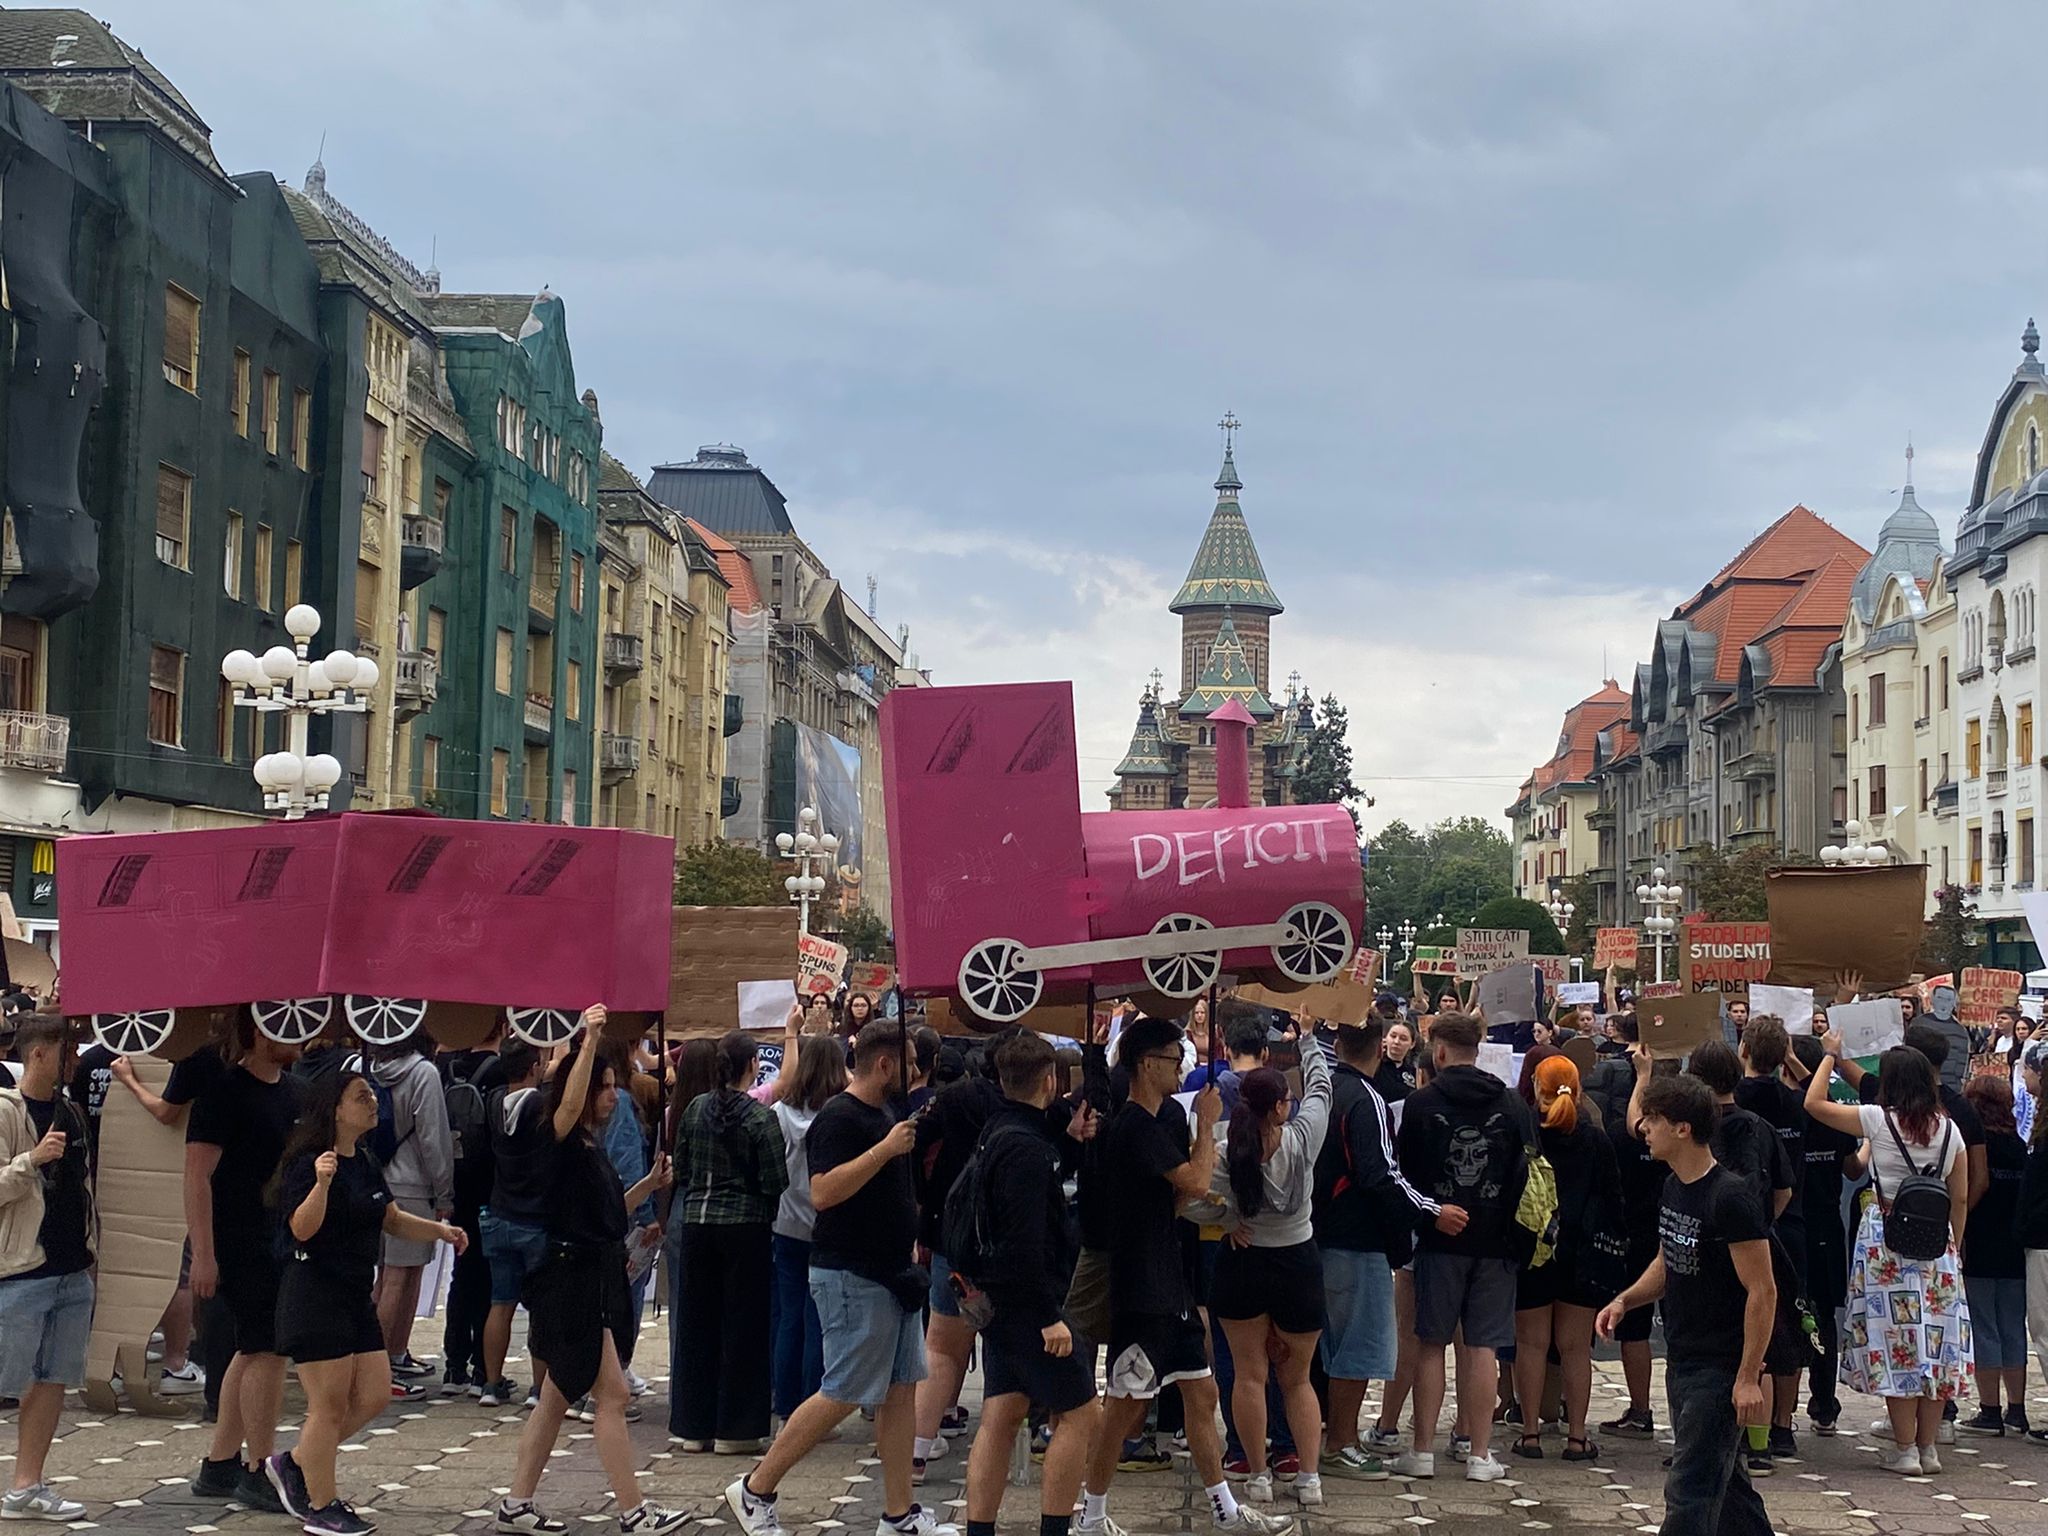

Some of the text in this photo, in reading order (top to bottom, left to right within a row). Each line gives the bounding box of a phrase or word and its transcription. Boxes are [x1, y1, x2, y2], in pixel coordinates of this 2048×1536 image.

[1130, 818, 1332, 885] DEFICIT
[799, 953, 837, 973] SPUNS
[799, 964, 816, 977] LTE
[1973, 988, 2003, 1003] CERE
